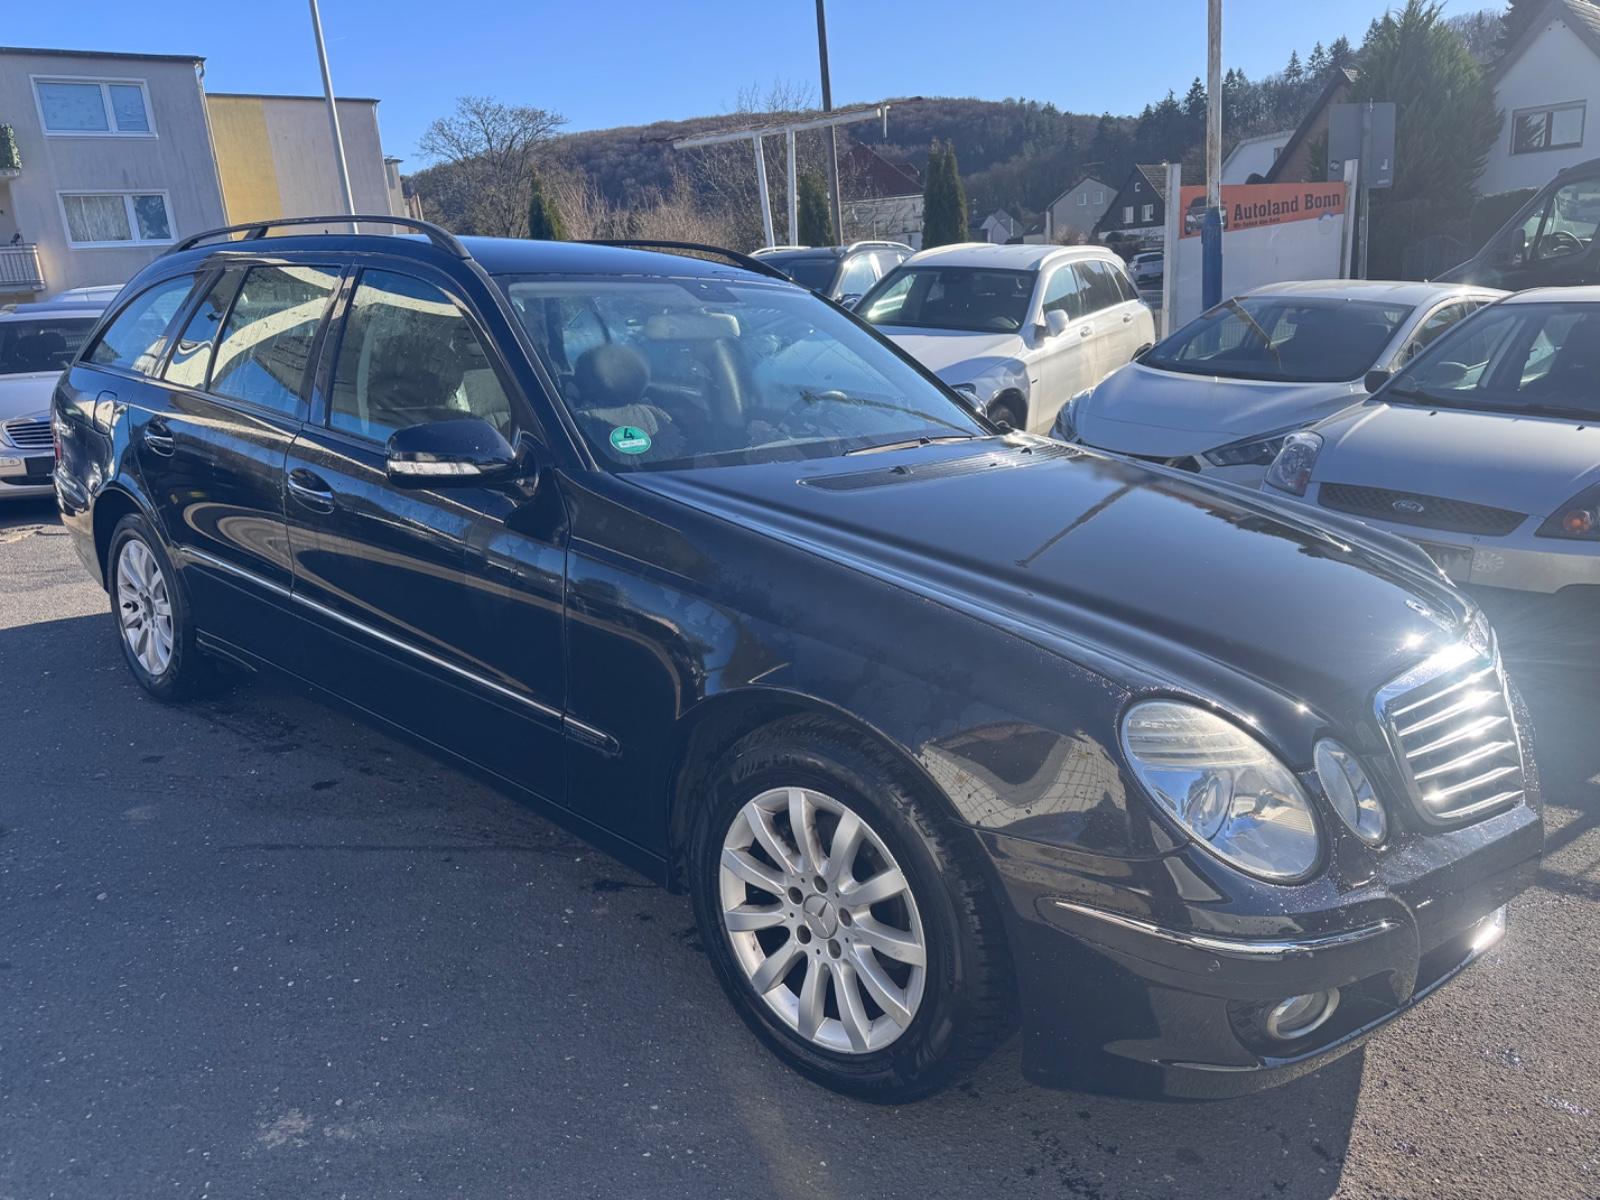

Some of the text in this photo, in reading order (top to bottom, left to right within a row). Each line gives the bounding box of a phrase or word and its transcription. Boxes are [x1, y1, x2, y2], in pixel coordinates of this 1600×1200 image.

[1234, 193, 1341, 221] Autoland Bonn
[623, 427, 635, 440] 4
